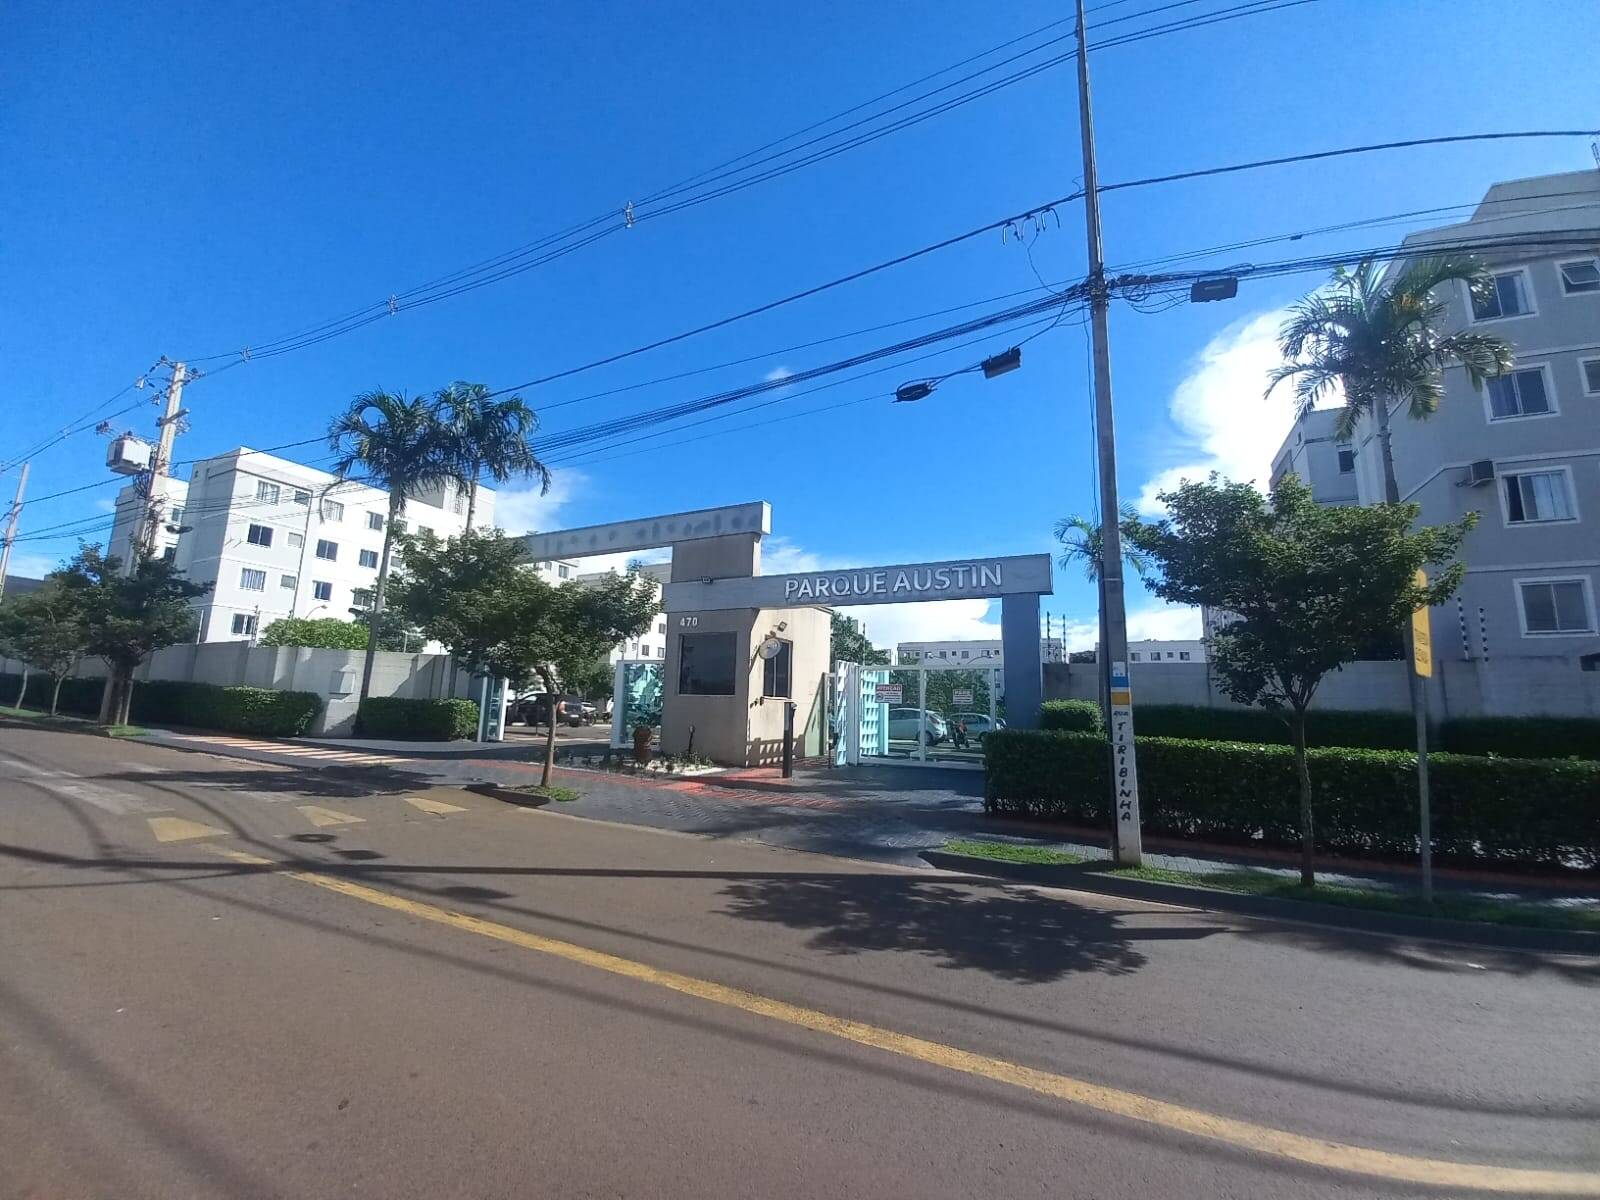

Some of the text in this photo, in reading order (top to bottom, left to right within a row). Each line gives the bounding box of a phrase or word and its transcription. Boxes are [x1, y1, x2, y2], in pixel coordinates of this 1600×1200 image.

[784, 563, 1001, 599] PARQUE AUSTIN
[679, 616, 698, 627] 470
[1117, 722, 1132, 821] TIRIBINHA
